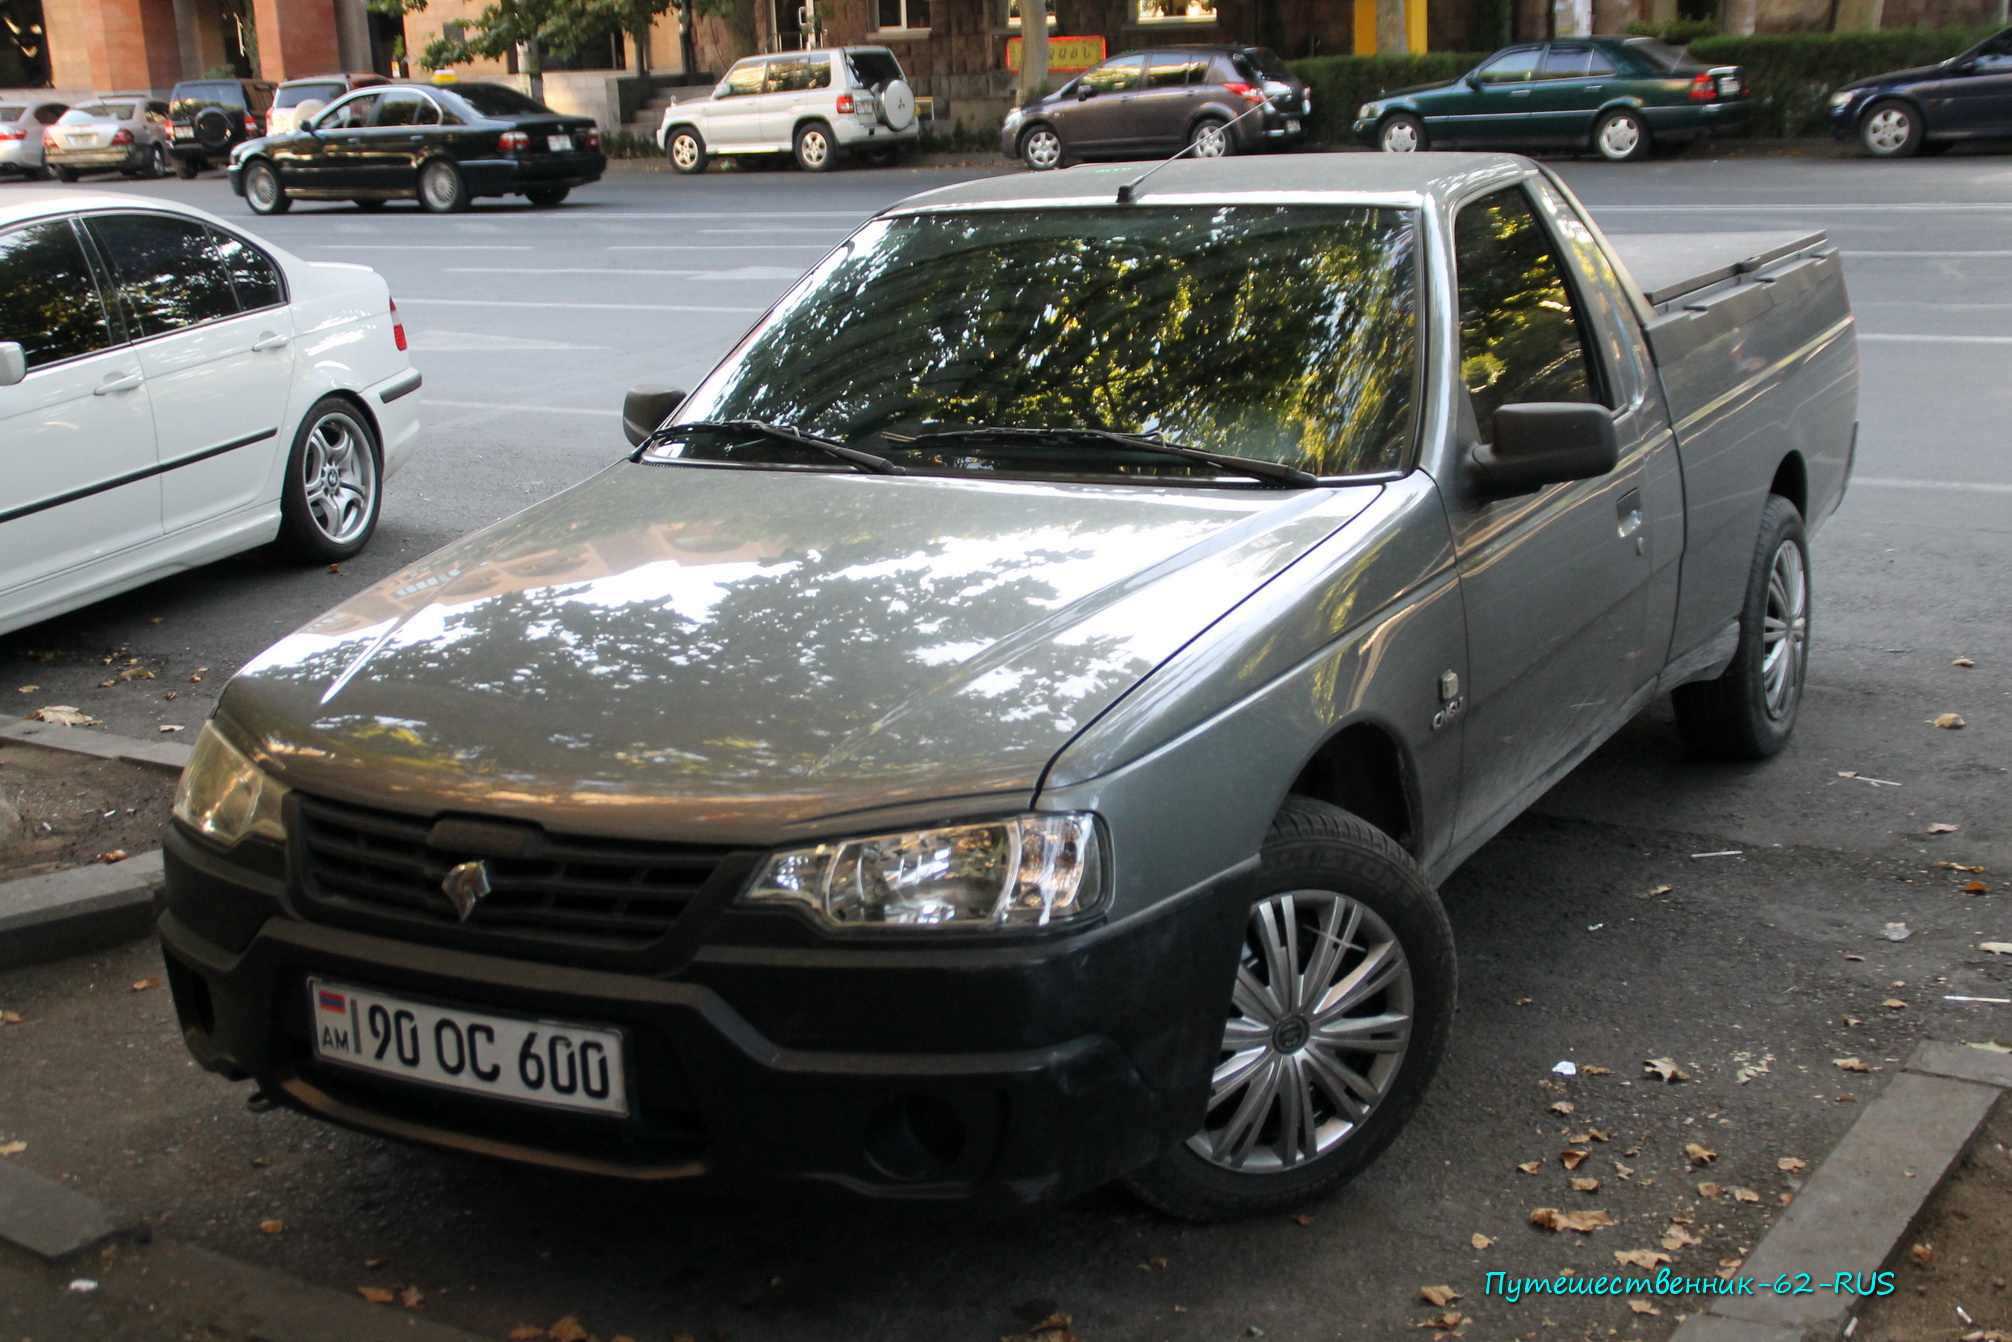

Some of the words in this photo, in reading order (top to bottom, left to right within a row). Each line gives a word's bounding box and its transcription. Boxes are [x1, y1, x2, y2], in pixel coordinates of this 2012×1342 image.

[322, 1026, 350, 1053] AM
[368, 1004, 421, 1068] 90
[434, 1017, 501, 1083] OC
[518, 1031, 610, 1100] 600
